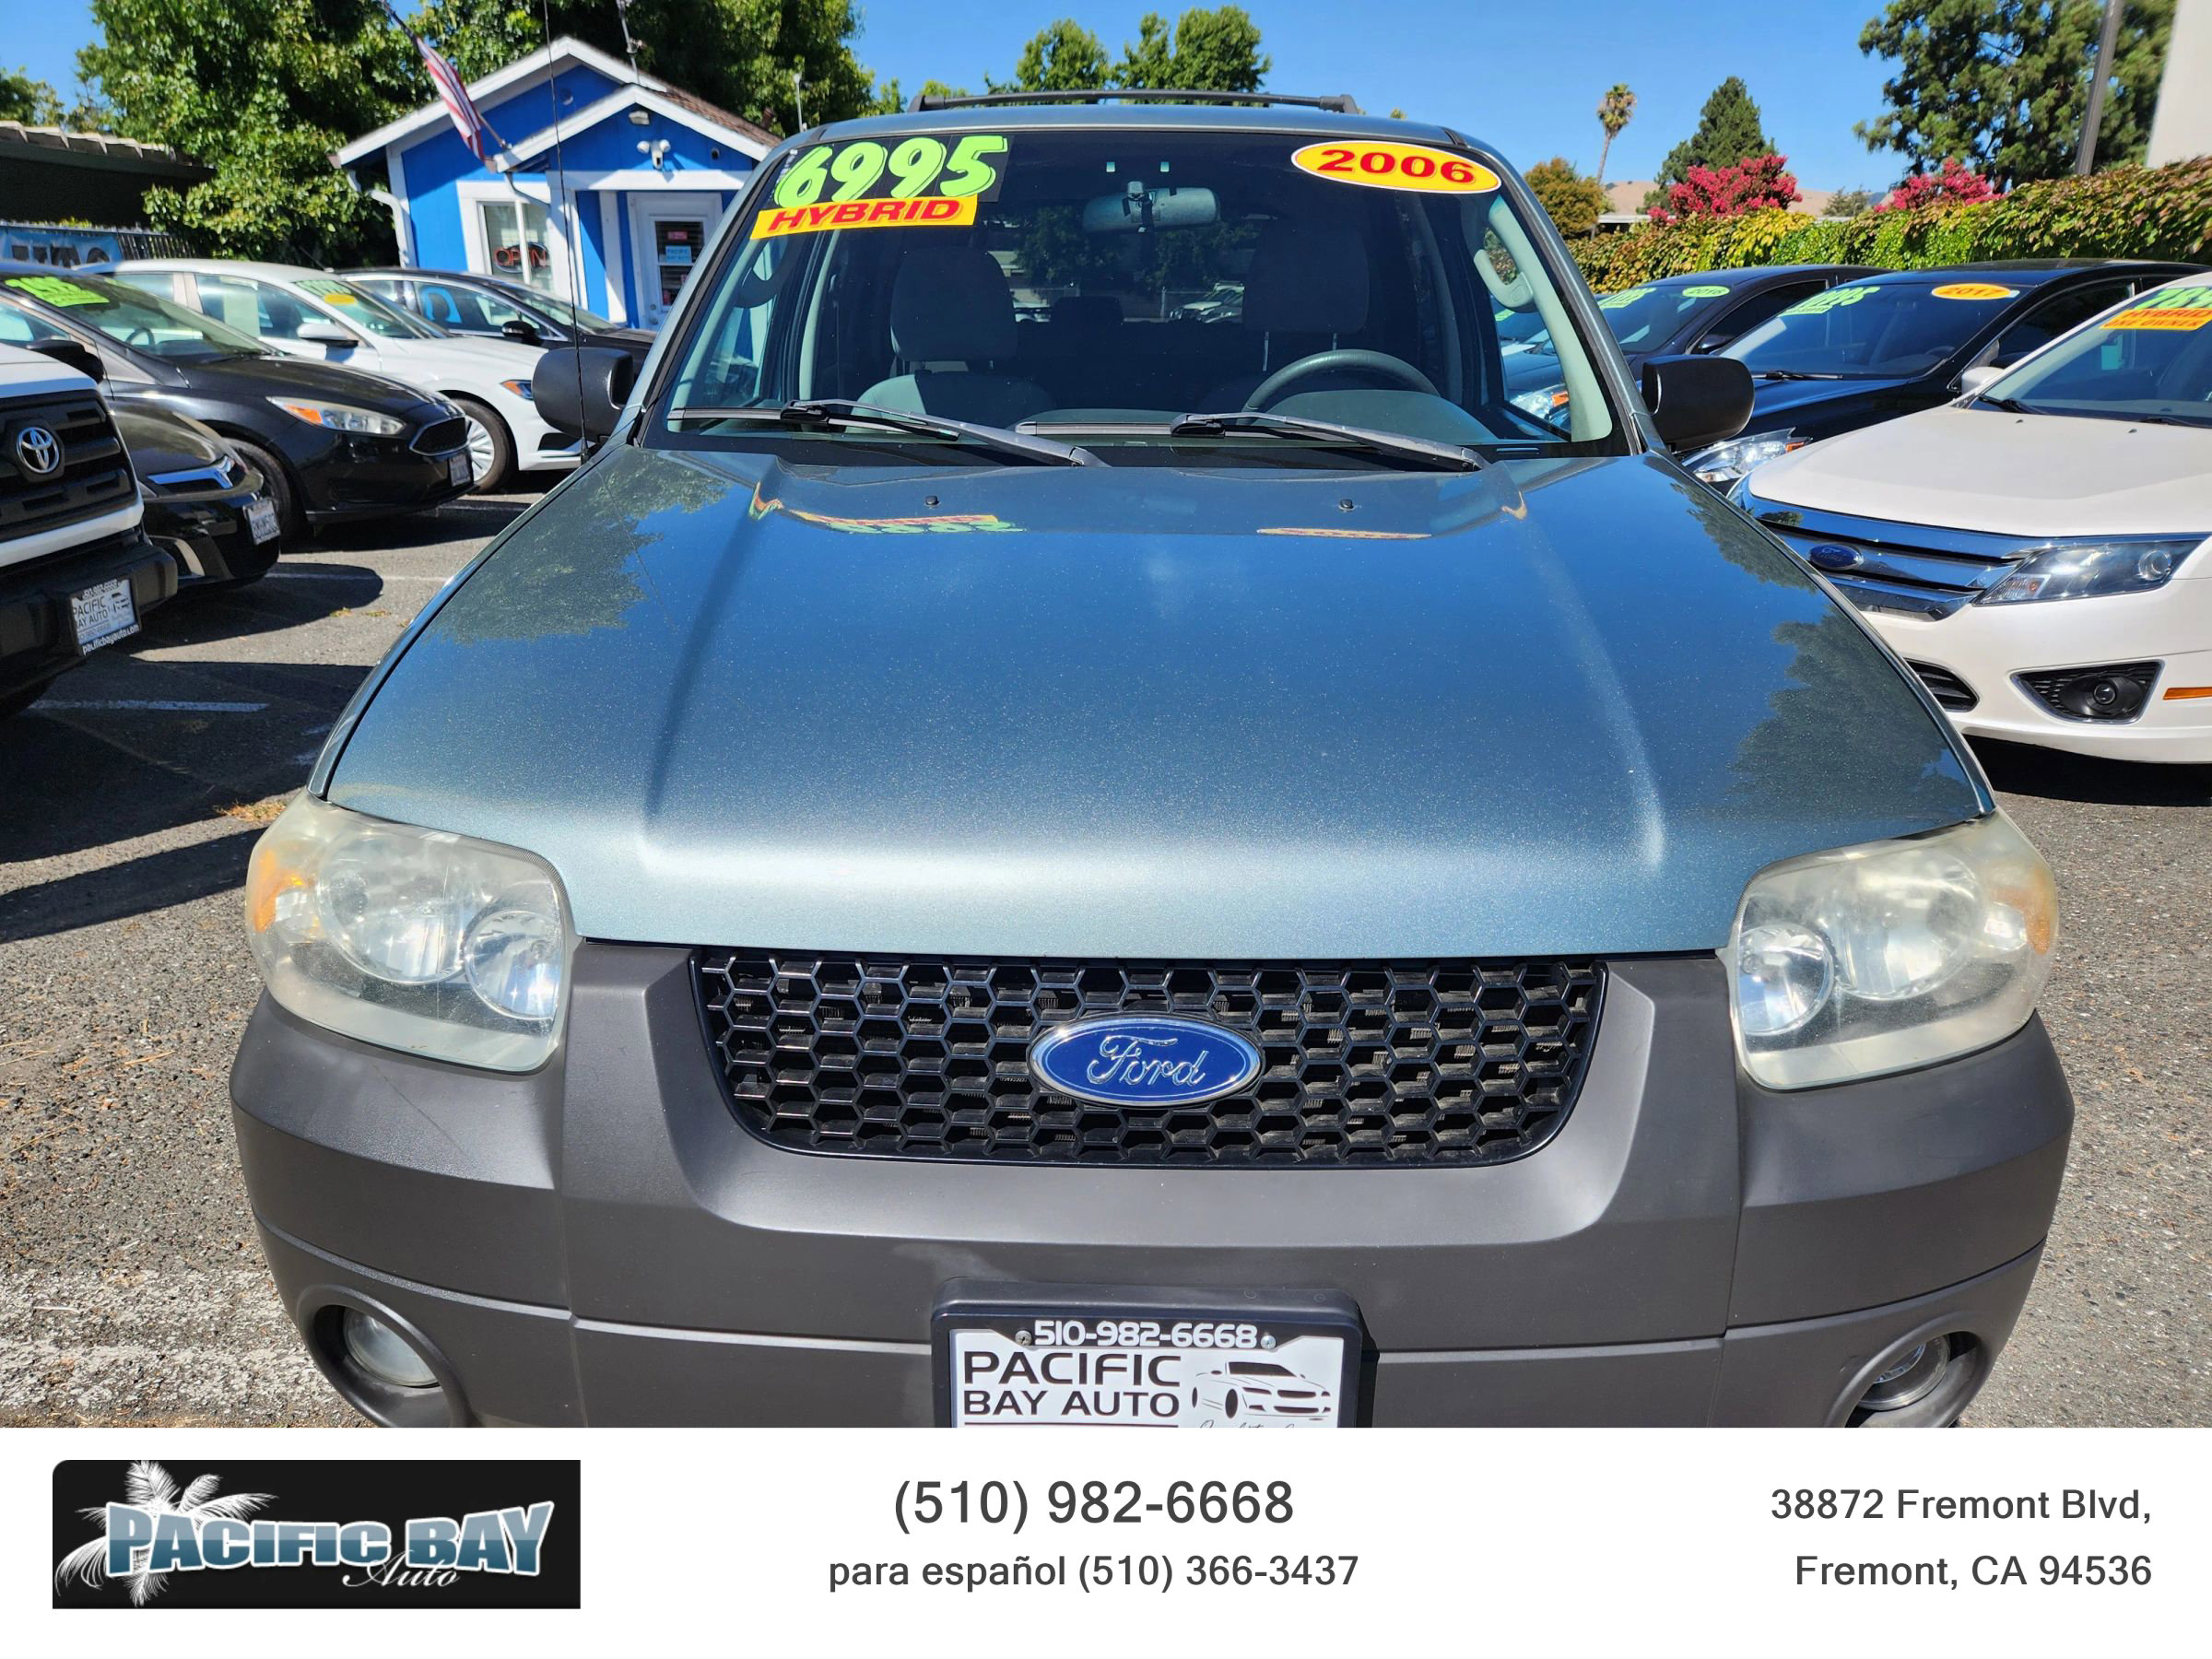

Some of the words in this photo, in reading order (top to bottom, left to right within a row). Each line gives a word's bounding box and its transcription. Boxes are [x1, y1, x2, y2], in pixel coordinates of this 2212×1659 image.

[774, 135, 1008, 208] 6995
[1317, 149, 1476, 183] 2006
[768, 199, 964, 231] HYBRID
[494, 248, 547, 267] OPN
[1086, 1034, 1210, 1087] Ford
[1034, 1320, 1258, 1349] 510-982-6668
[963, 1351, 1182, 1388] PACIFIC
[963, 1390, 1048, 1417] BAY
[1061, 1390, 1180, 1418] AUTO
